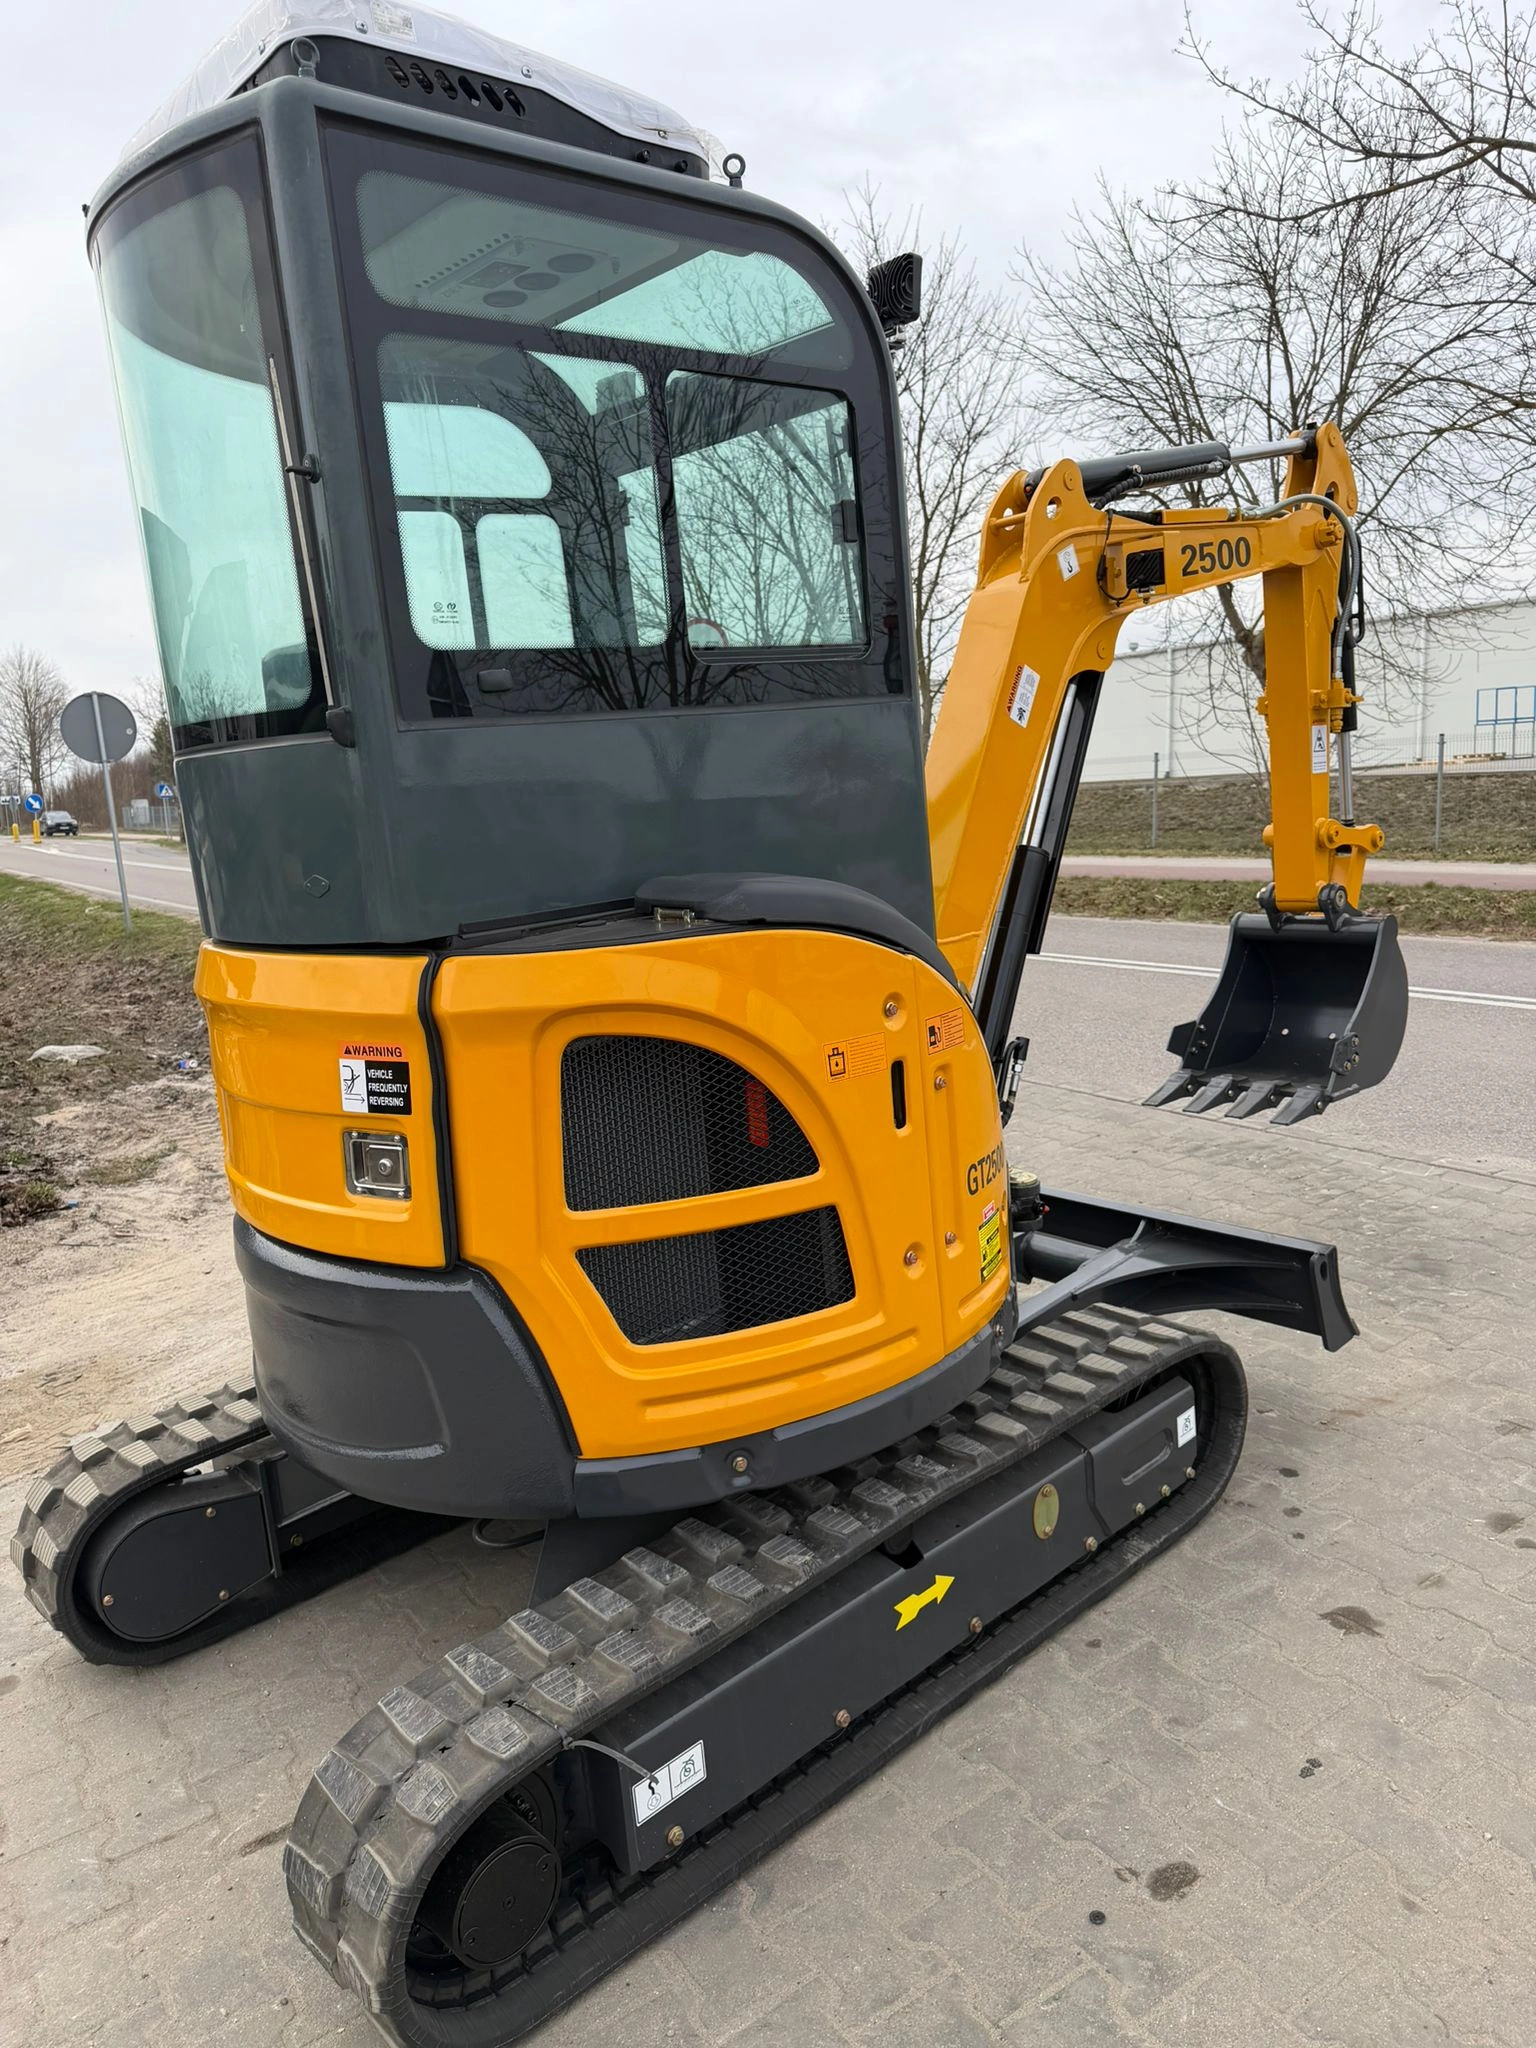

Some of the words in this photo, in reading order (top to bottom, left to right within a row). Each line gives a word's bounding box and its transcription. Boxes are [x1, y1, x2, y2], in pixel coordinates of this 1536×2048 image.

[1181, 536, 1251, 577] 2500
[352, 1045, 403, 1058] WARNING
[367, 1069, 393, 1079] VEHICLE
[368, 1083, 408, 1093] FREQUENTLY
[369, 1096, 404, 1107] REVERSING
